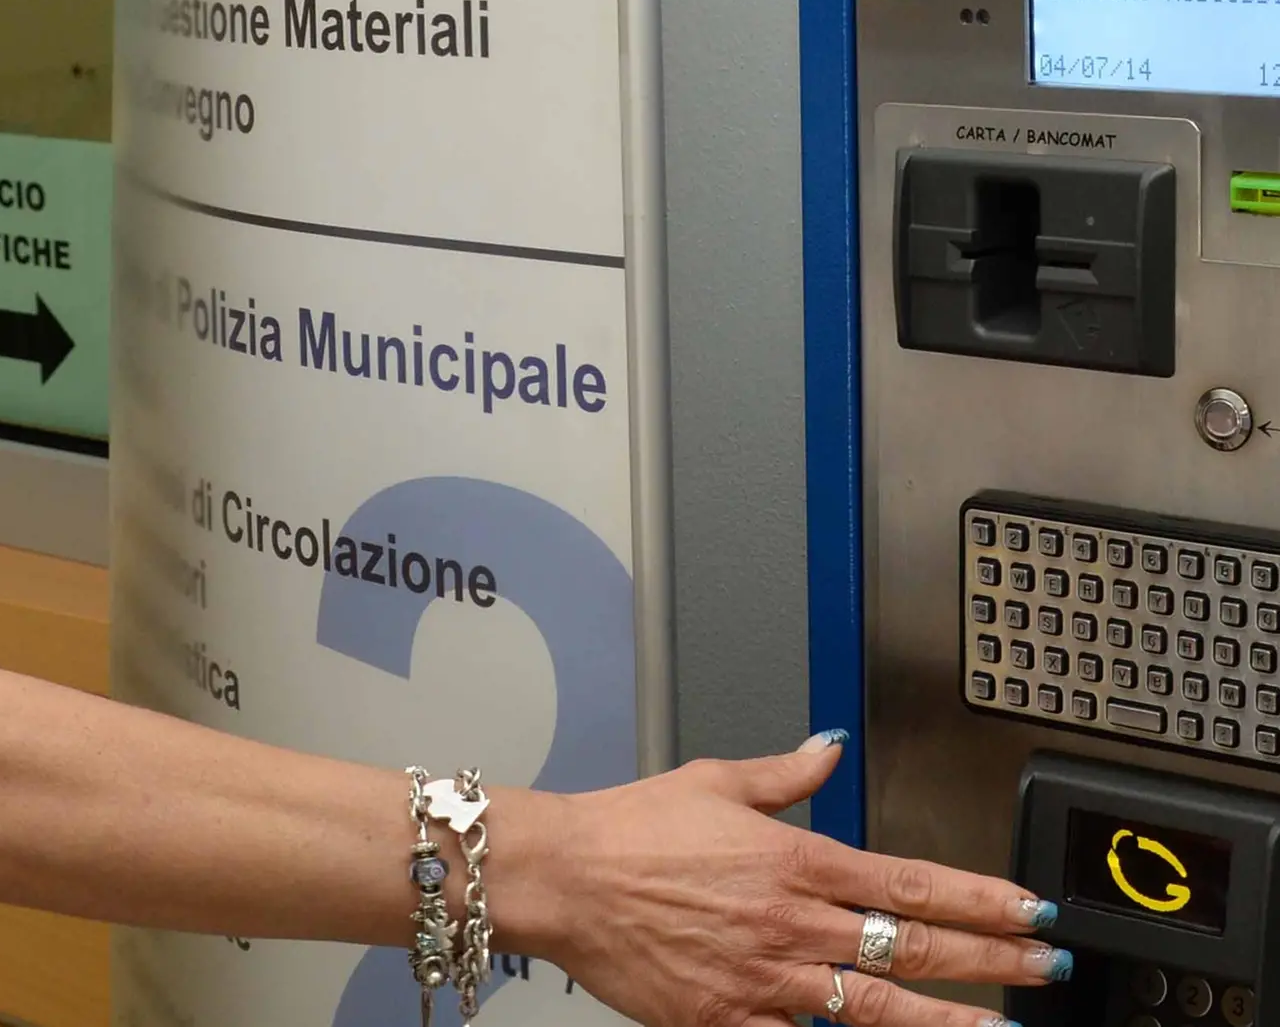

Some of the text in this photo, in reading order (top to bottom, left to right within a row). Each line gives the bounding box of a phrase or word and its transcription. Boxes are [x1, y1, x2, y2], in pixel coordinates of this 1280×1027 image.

[1040, 53, 1152, 82] 04/07/14
[956, 125, 1006, 143] CARTA
[1027, 129, 1117, 150] BANCOMAT
[177, 277, 283, 362] Polizia
[298, 307, 608, 413] Municipale
[192, 478, 213, 531] di
[222, 490, 497, 609] Circolazione
